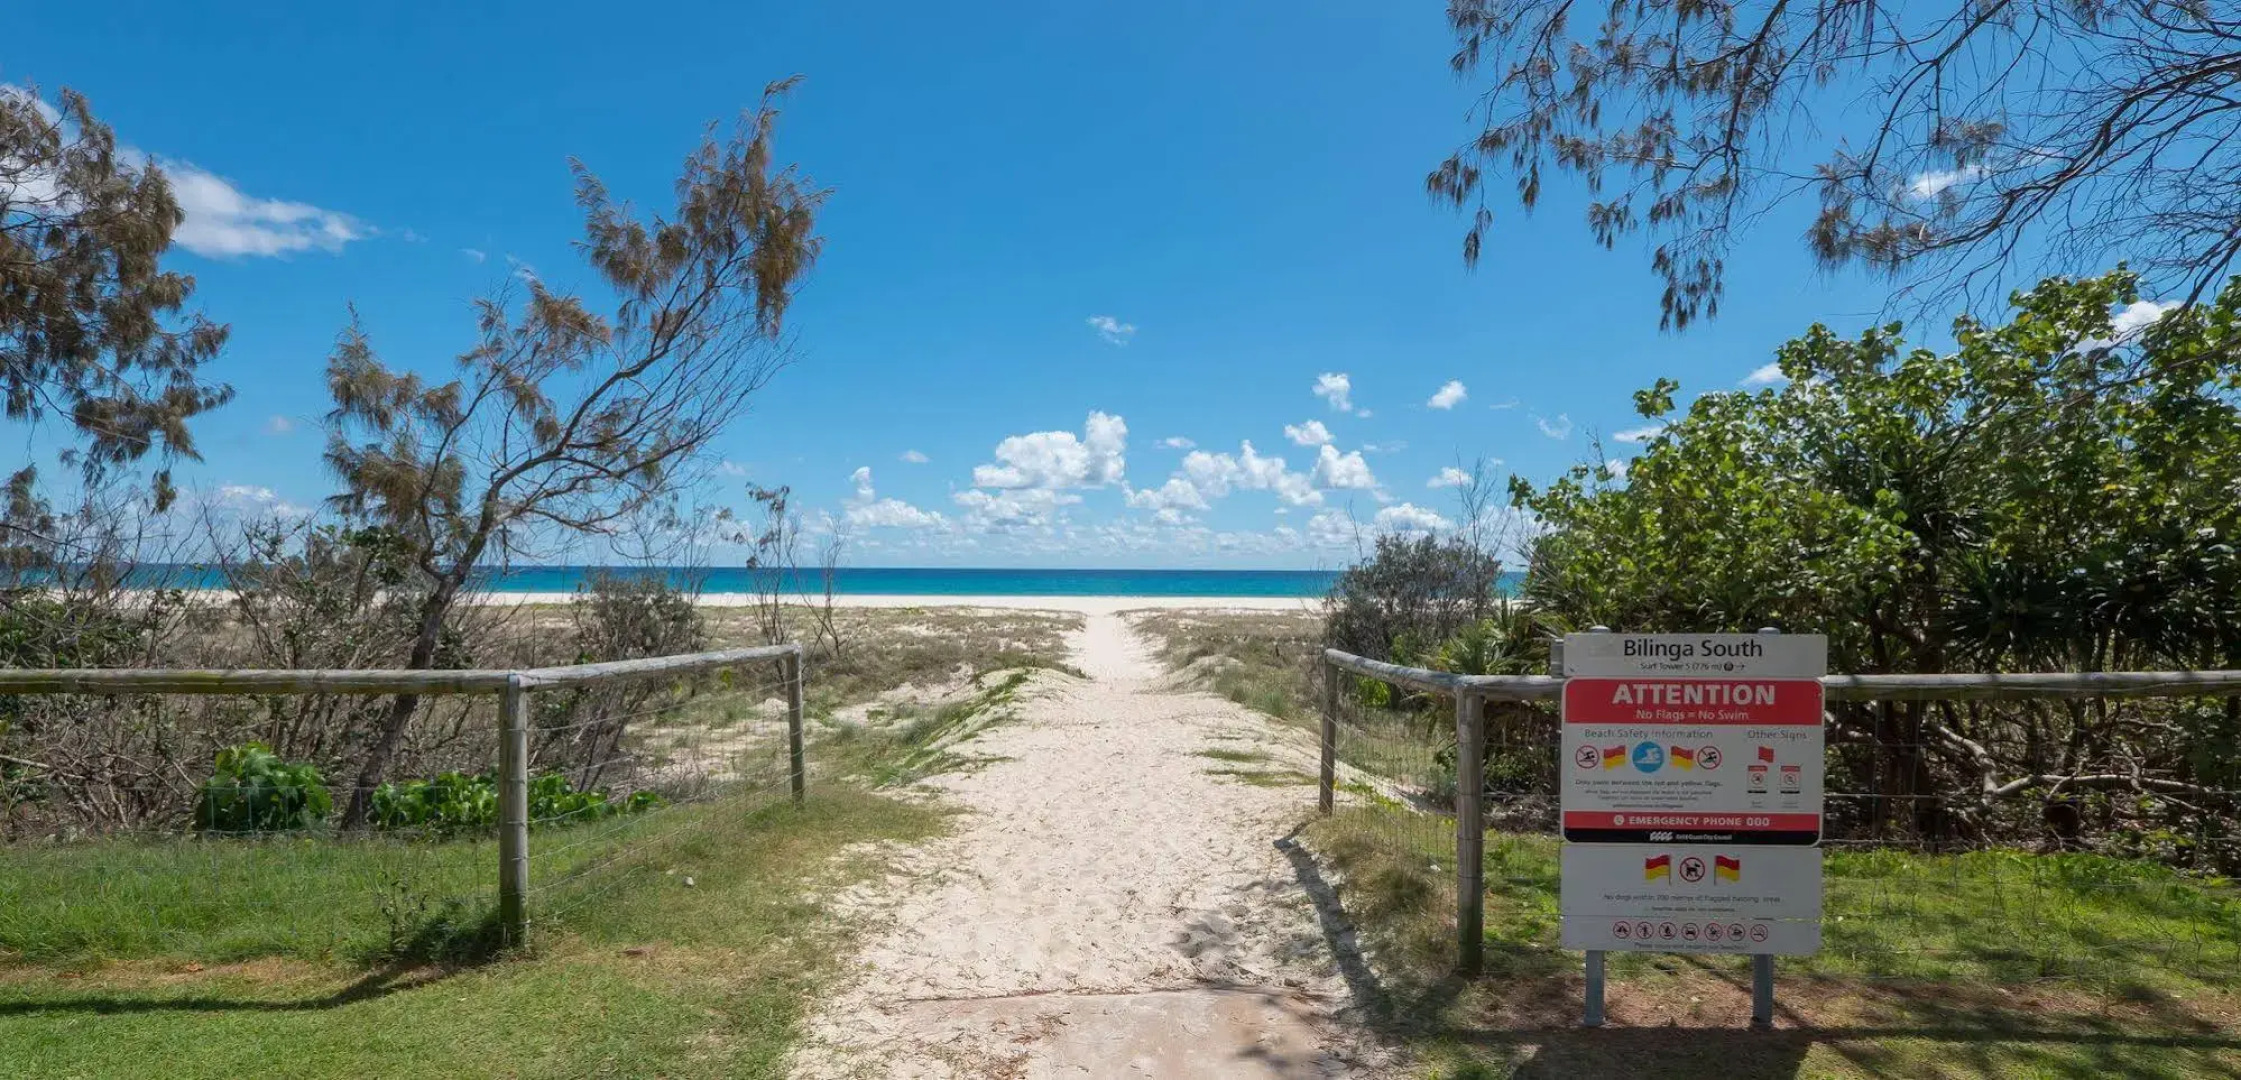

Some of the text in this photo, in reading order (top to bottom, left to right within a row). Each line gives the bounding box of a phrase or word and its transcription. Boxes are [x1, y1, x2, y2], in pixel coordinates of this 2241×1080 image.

[1624, 639, 1763, 661] Bilinga South
[1612, 684, 1776, 706] ATTENTION
[1636, 710, 1653, 719] No
[1656, 709, 1685, 721] Flags
[1698, 710, 1715, 720] No
[1718, 710, 1749, 720] Swim
[1584, 729, 1713, 740] Beach Safety Information
[1748, 730, 1808, 742] Other Signs
[1629, 816, 1771, 827] EMERGENCY PHONE 000
